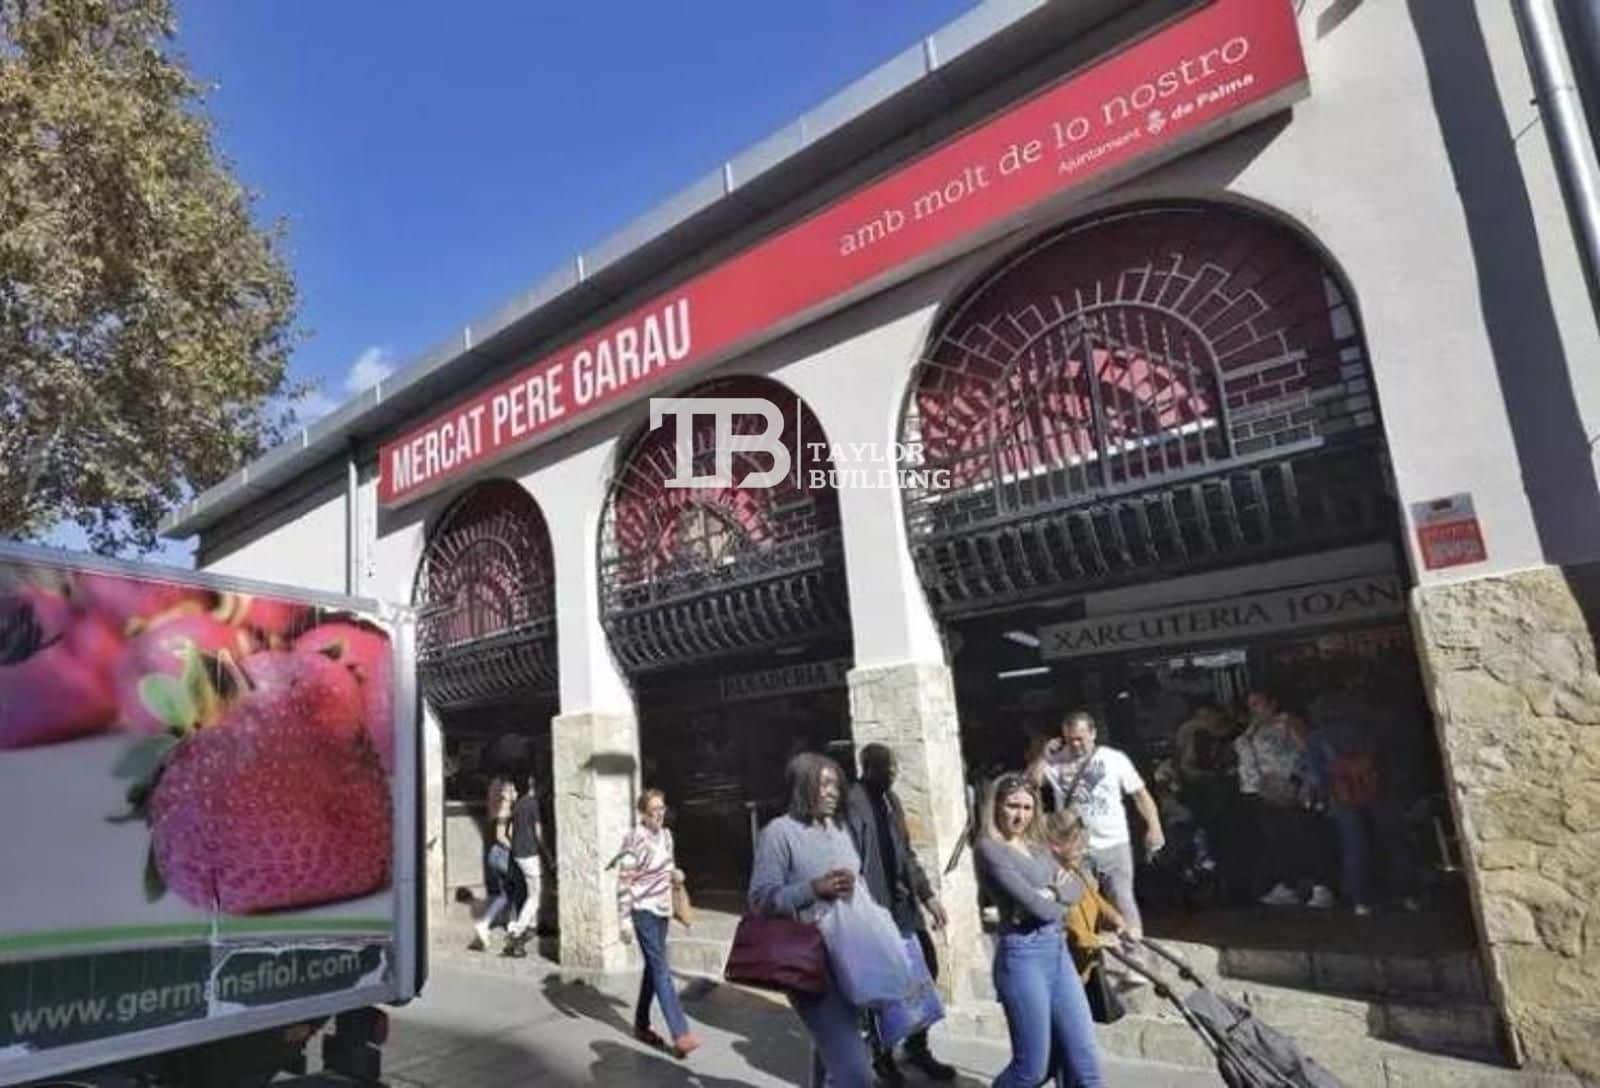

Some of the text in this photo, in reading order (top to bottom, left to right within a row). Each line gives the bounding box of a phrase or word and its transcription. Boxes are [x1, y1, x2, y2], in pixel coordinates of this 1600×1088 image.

[838, 34, 1250, 258] amb molt de lo nostro
[1058, 73, 1255, 176] Ajuntament de Palma
[391, 298, 691, 494] MERCAT PERE GARAU
[1053, 603, 1271, 655] XARCUTERIA
